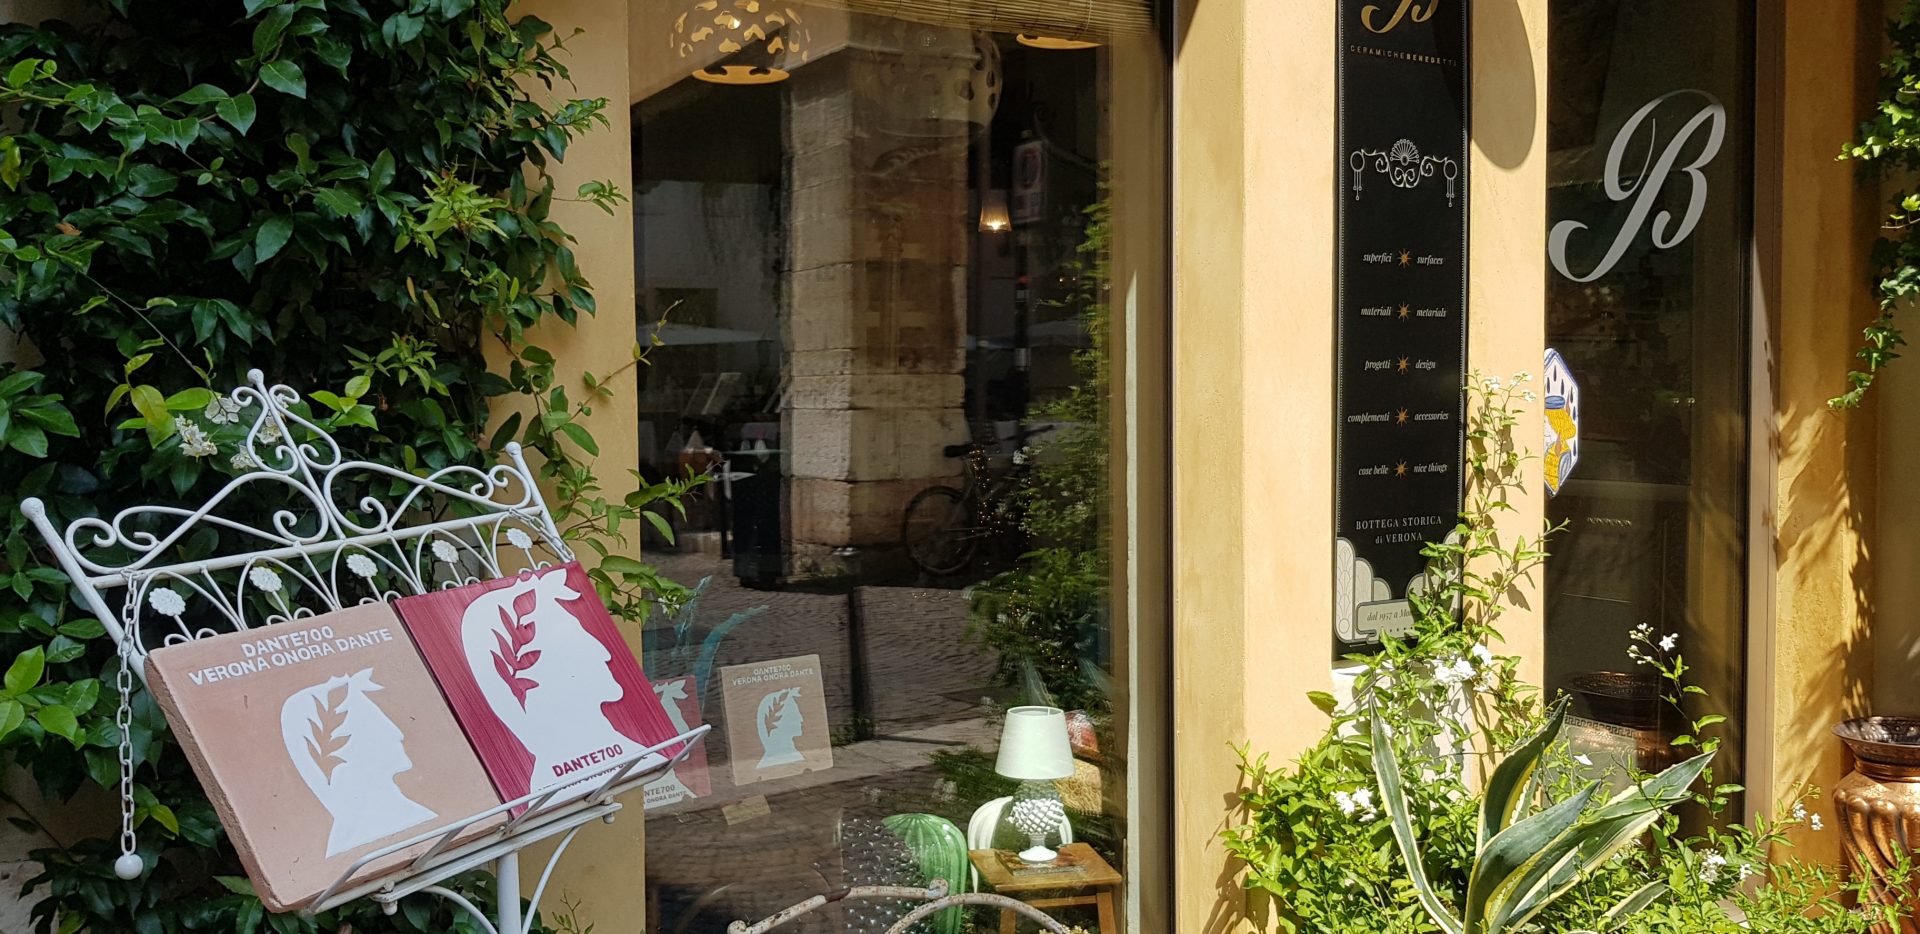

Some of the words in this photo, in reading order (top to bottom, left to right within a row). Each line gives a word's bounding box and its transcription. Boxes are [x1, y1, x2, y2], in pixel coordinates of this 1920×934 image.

[1362, 252, 1393, 264] superfici
[1416, 254, 1444, 266] surfaces
[1360, 306, 1392, 316] materiali
[1364, 359, 1391, 371] progetti
[1415, 359, 1436, 371] design
[1347, 411, 1391, 424] complementi
[1414, 410, 1449, 421] accessories
[1373, 464, 1389, 475] belle
[1413, 463, 1428, 473] nice
[1427, 462, 1448, 474] things
[1356, 518, 1400, 530] BOTTEGA
[1402, 515, 1442, 527] STORICA
[1375, 535, 1383, 544] di
[1385, 532, 1423, 543] VERONA
[240, 625, 334, 658] DANTE700
[188, 658, 271, 686] VERONA
[271, 642, 337, 667] ONORA
[335, 628, 394, 652] DANTE
[732, 675, 762, 686] VERONA
[763, 671, 789, 681] ONORA
[790, 668, 814, 678] DANTE
[552, 744, 624, 777] DANTE700
[644, 784, 676, 797] NTE700
